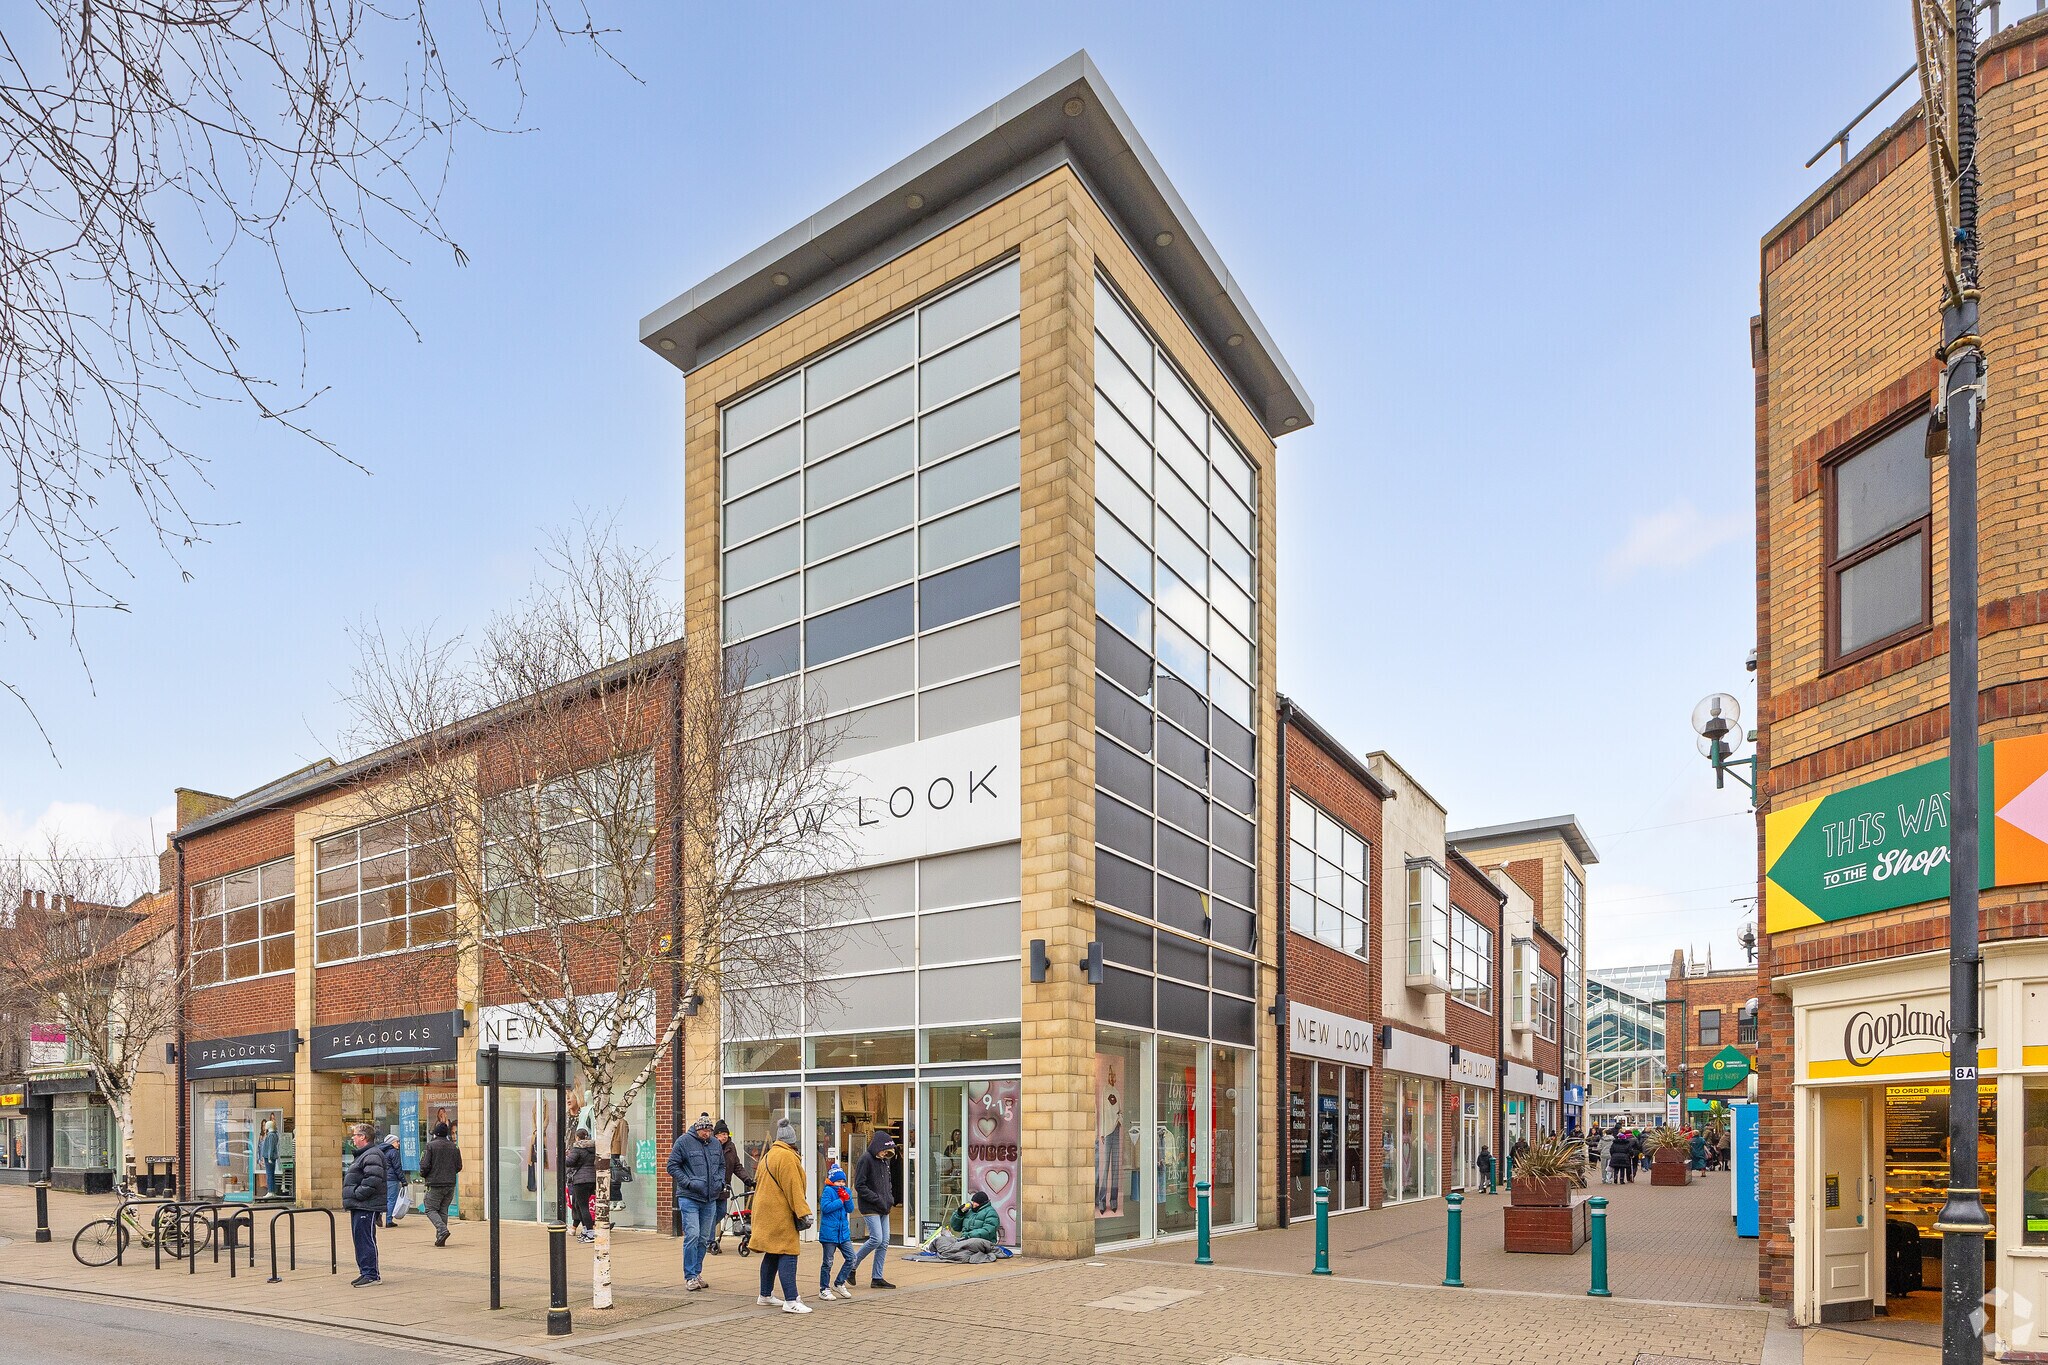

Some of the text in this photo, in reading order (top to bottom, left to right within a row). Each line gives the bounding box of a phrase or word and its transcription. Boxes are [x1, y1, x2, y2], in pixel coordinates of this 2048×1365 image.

[731, 765, 998, 846] NEW LOOK
[1822, 791, 1951, 858] THIS WA
[1823, 873, 1840, 886] TO
[1843, 866, 1867, 881] THE
[333, 1027, 431, 1047] PEACOCKS
[486, 1016, 546, 1042] NEW
[1297, 1017, 1369, 1054] NEW LOOK
[202, 1043, 276, 1060] PEACOCKS
[1475, 1062, 1492, 1080] LOOK
[968, 1145, 1018, 1161] VIBES
